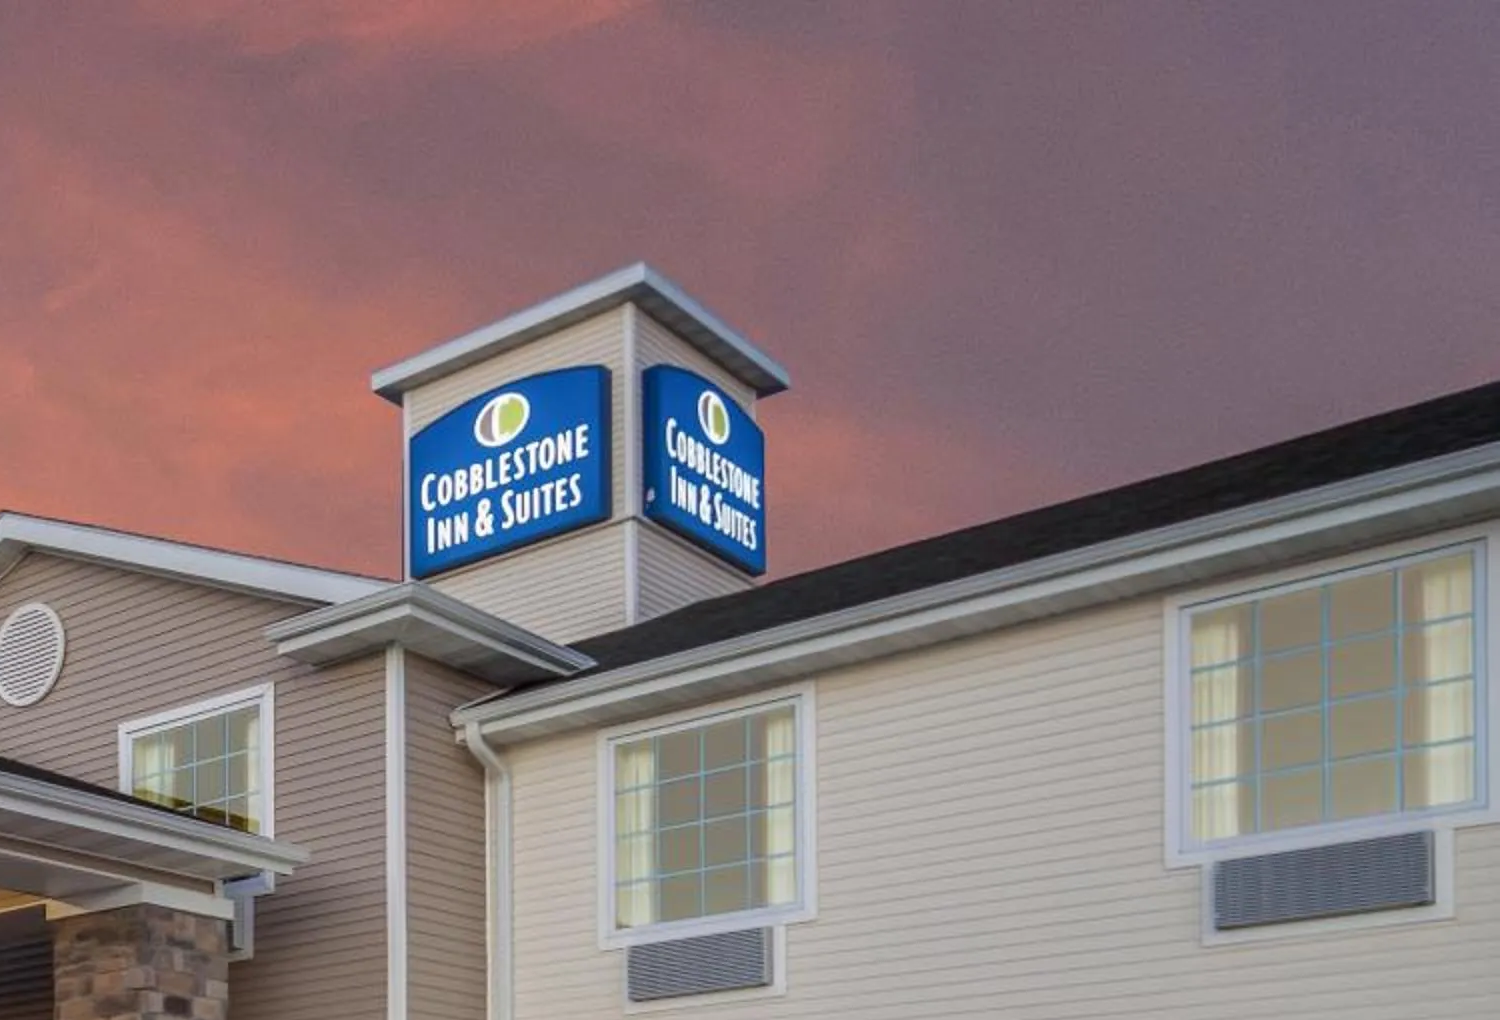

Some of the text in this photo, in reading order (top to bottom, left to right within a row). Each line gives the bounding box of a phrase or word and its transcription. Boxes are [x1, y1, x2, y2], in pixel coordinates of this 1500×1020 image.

[421, 424, 589, 512] COBBLESTONE
[665, 418, 759, 509] COBBLESTONE
[426, 473, 582, 554] INN & SUITES
[670, 466, 757, 551] INN & SUITES
